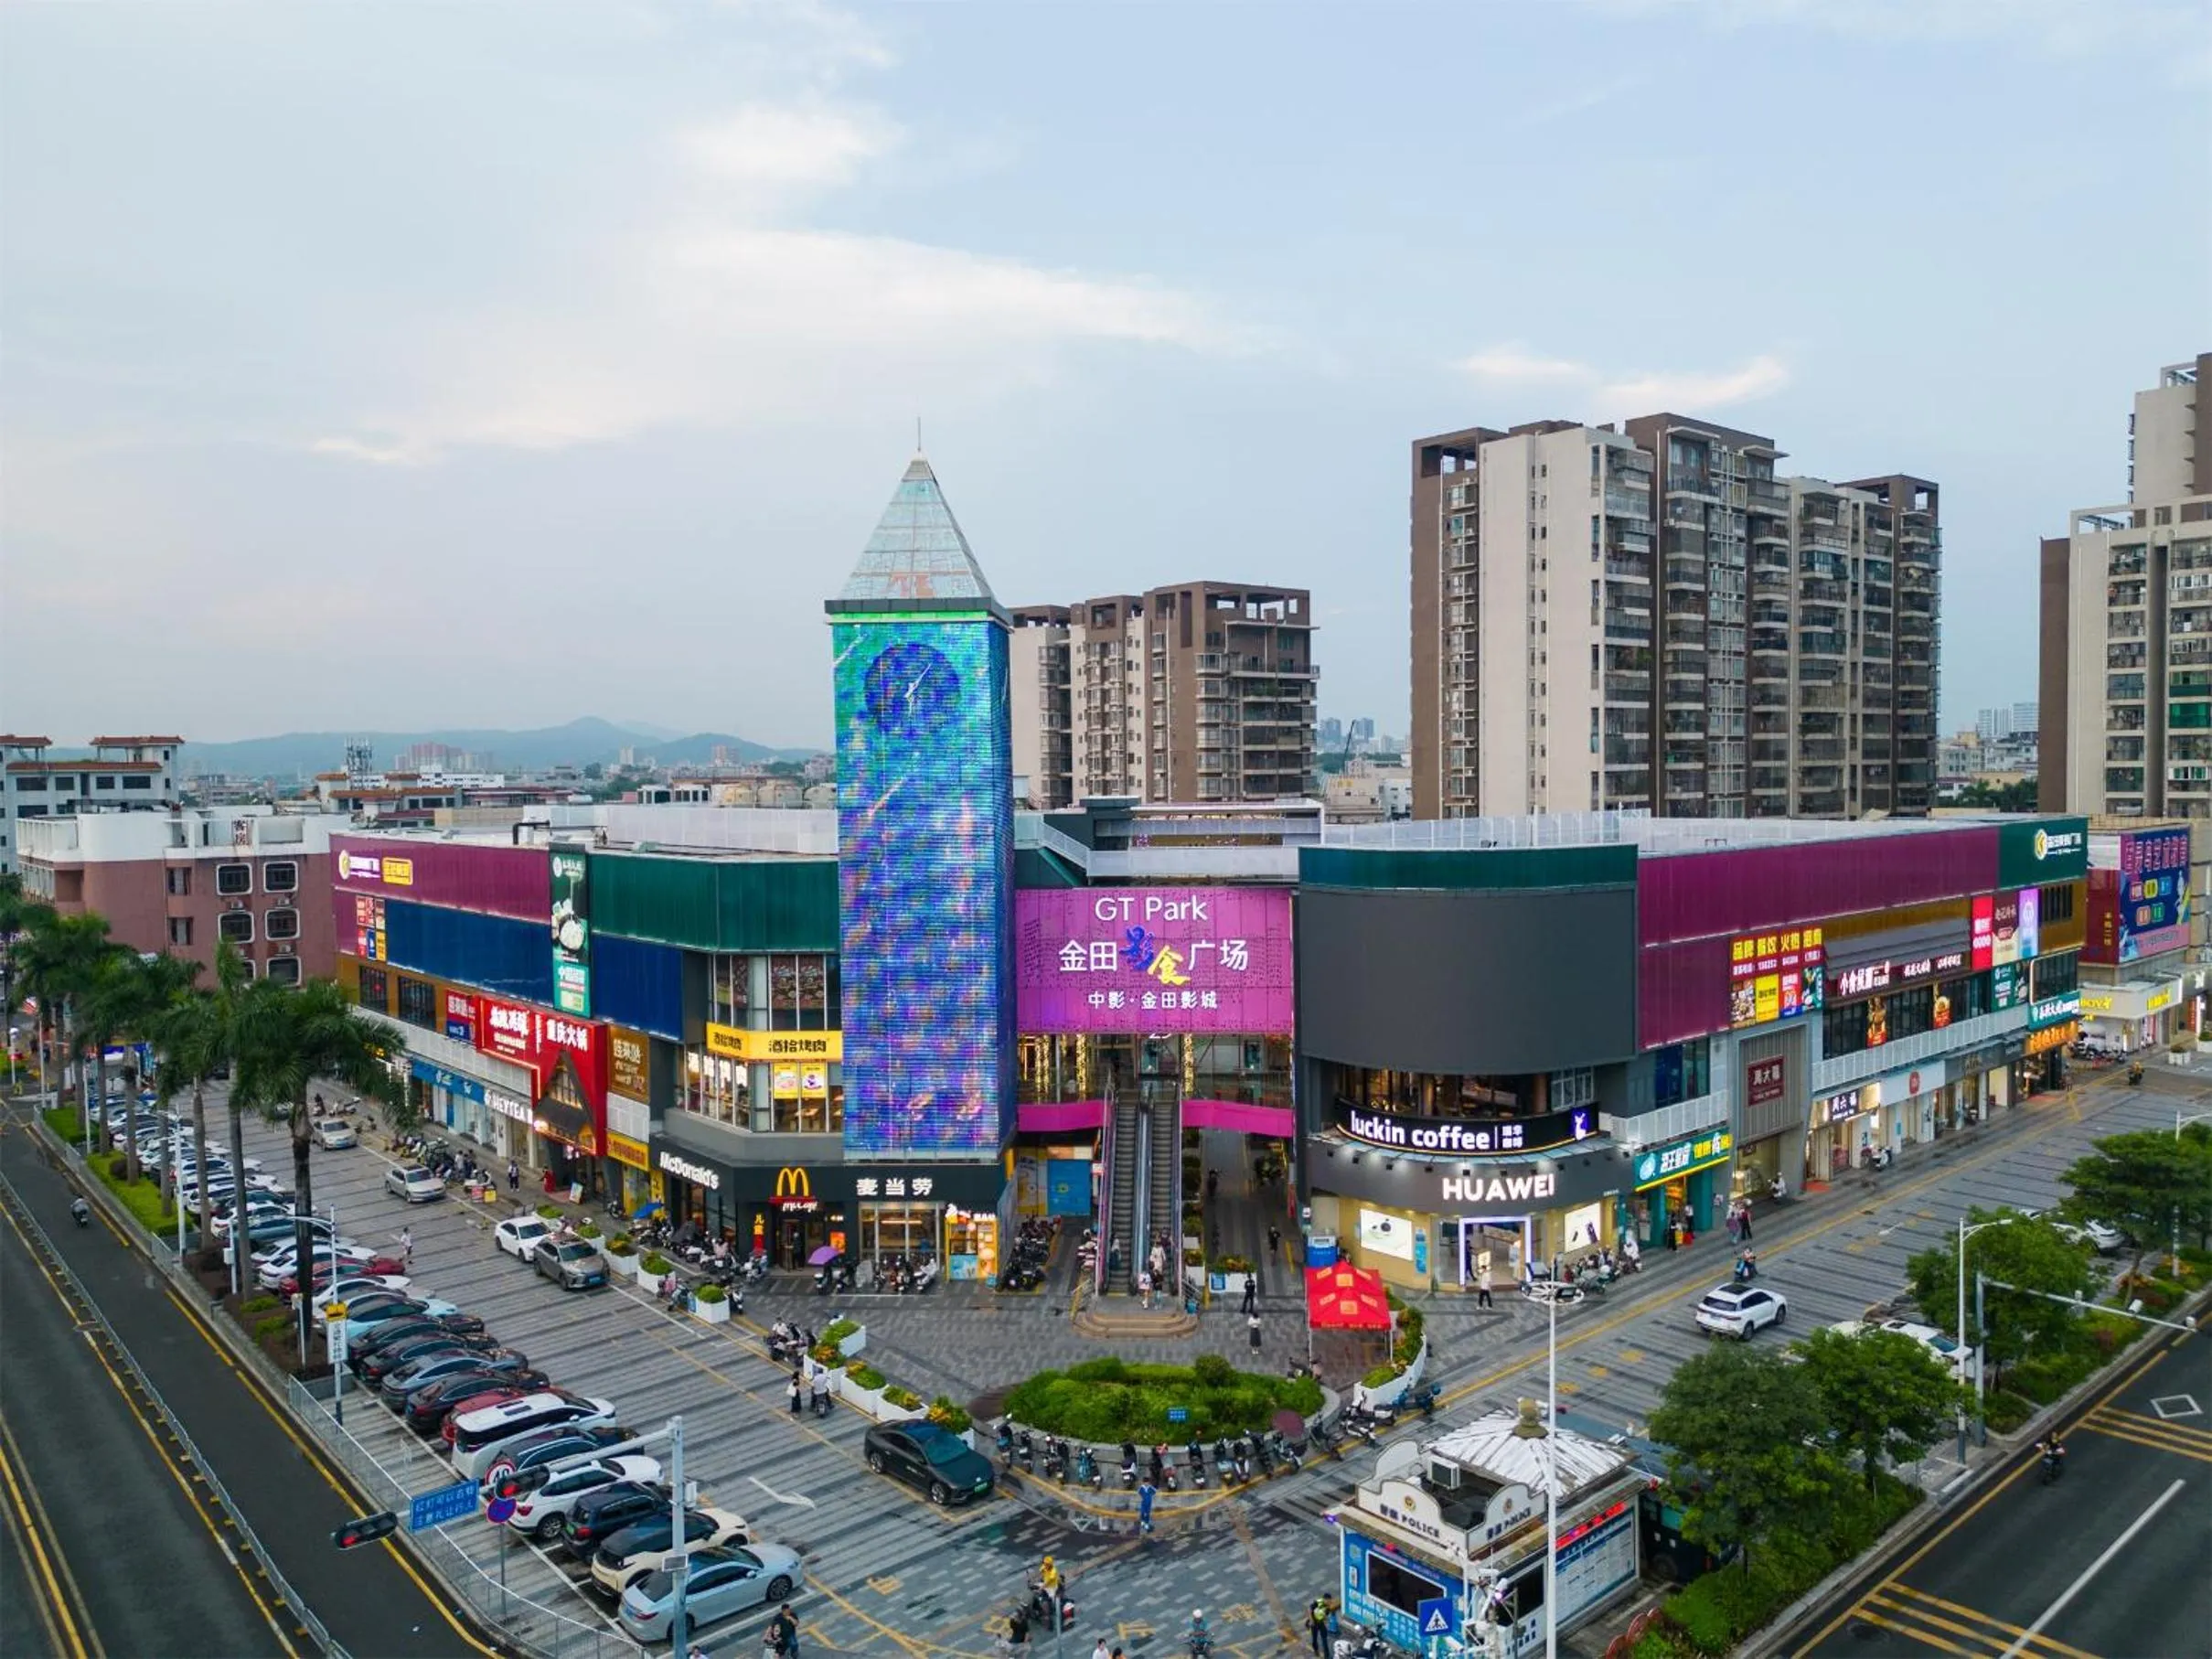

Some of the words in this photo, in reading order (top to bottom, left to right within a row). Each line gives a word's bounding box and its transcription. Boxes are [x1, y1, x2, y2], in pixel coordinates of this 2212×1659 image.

[1095, 897, 1134, 921] GT
[1145, 895, 1208, 921] Park
[1351, 1110, 1405, 1145] luckin
[1412, 1124, 1490, 1151] coffee
[659, 1151, 719, 1190] McDonald's
[856, 1177, 934, 1197] 麦当劳
[1442, 1174, 1555, 1202] HUAWEI
[1401, 1514, 1441, 1538] POLICE
[1503, 1506, 1532, 1529] POLICE
